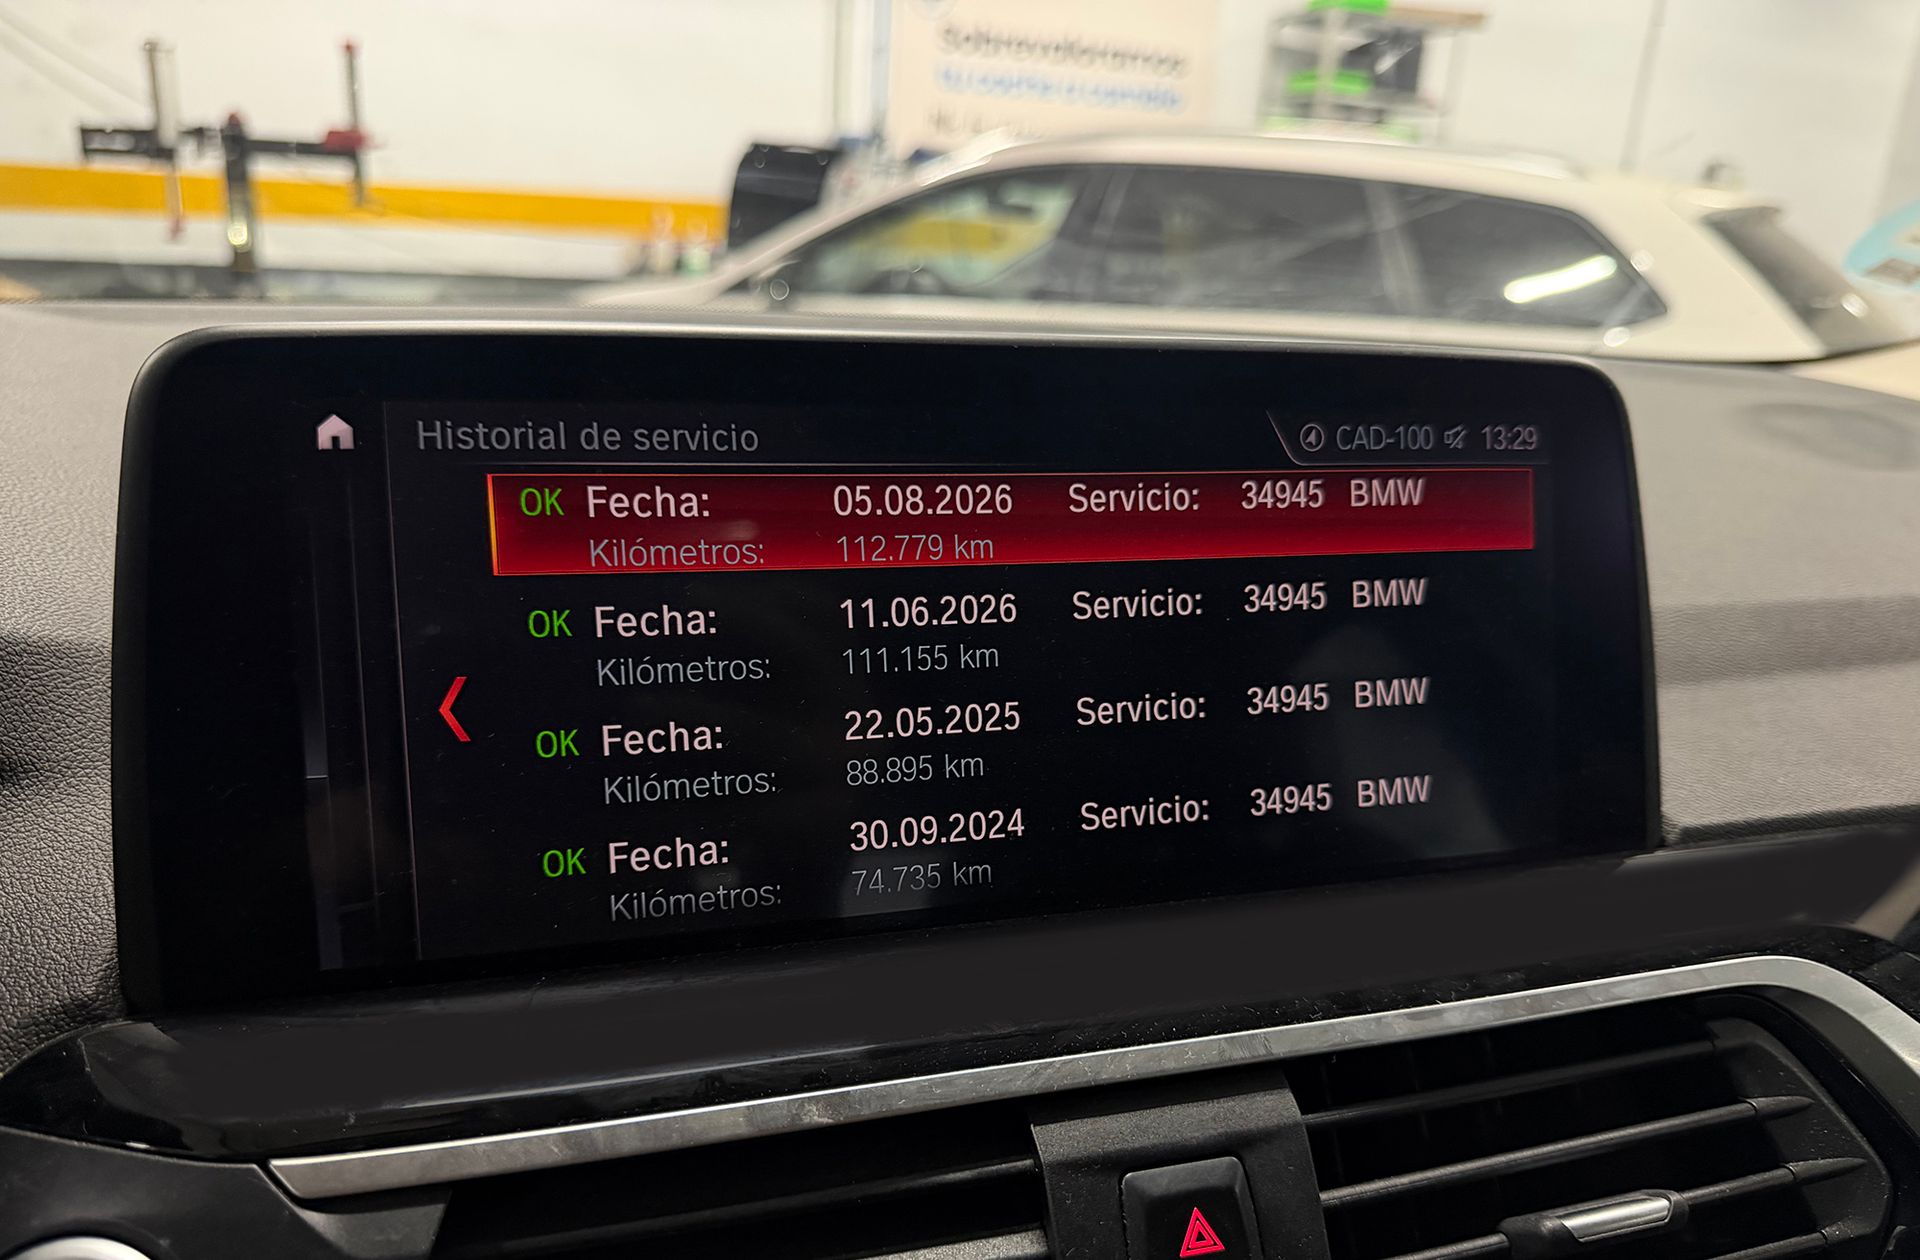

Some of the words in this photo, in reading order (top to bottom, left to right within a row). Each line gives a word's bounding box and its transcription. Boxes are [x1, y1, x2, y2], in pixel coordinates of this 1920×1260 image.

[417, 420, 566, 450] Historial
[580, 421, 621, 451] de
[633, 423, 759, 452] servicio
[1336, 425, 1434, 451] CAD-100
[1481, 425, 1538, 450] 13:29
[520, 487, 565, 517] OK
[586, 485, 710, 518] Fecha:
[833, 484, 1013, 516] 05.08.2026
[1068, 482, 1199, 513] Servicio:
[1241, 479, 1324, 510] 34945
[1350, 478, 1423, 507] BMW
[589, 537, 764, 566] Kilómetros:
[836, 533, 944, 562] 112.779
[954, 533, 994, 560] km
[528, 609, 573, 638] OK
[594, 604, 717, 638] Fecha:
[840, 593, 1017, 629] 11.06.2026
[1072, 587, 1202, 620] Servicio:
[1244, 581, 1326, 613] 34945
[1352, 578, 1426, 608] BMW
[597, 655, 770, 687] Kilómetros:
[842, 644, 948, 675] 111.155
[959, 643, 999, 669] km
[536, 729, 580, 759] OK
[602, 721, 723, 757] Fecha:
[844, 701, 1020, 741] 22.05.2025
[1076, 691, 1206, 726] Servicio:
[1247, 682, 1328, 715] 34945
[1354, 677, 1427, 708] BMW
[604, 770, 776, 805] Kilómetros:
[846, 754, 933, 786] 88.895
[944, 753, 984, 779] km
[543, 847, 587, 878] OK
[608, 836, 729, 874] Fecha:
[850, 808, 1025, 852] 30.09.2024
[1080, 794, 1209, 831] Servicio:
[1250, 782, 1332, 817] 34945
[1357, 775, 1430, 808] BMW
[610, 884, 781, 921] Kilómetros:
[851, 862, 941, 896] 74.735
[953, 861, 992, 886] km
